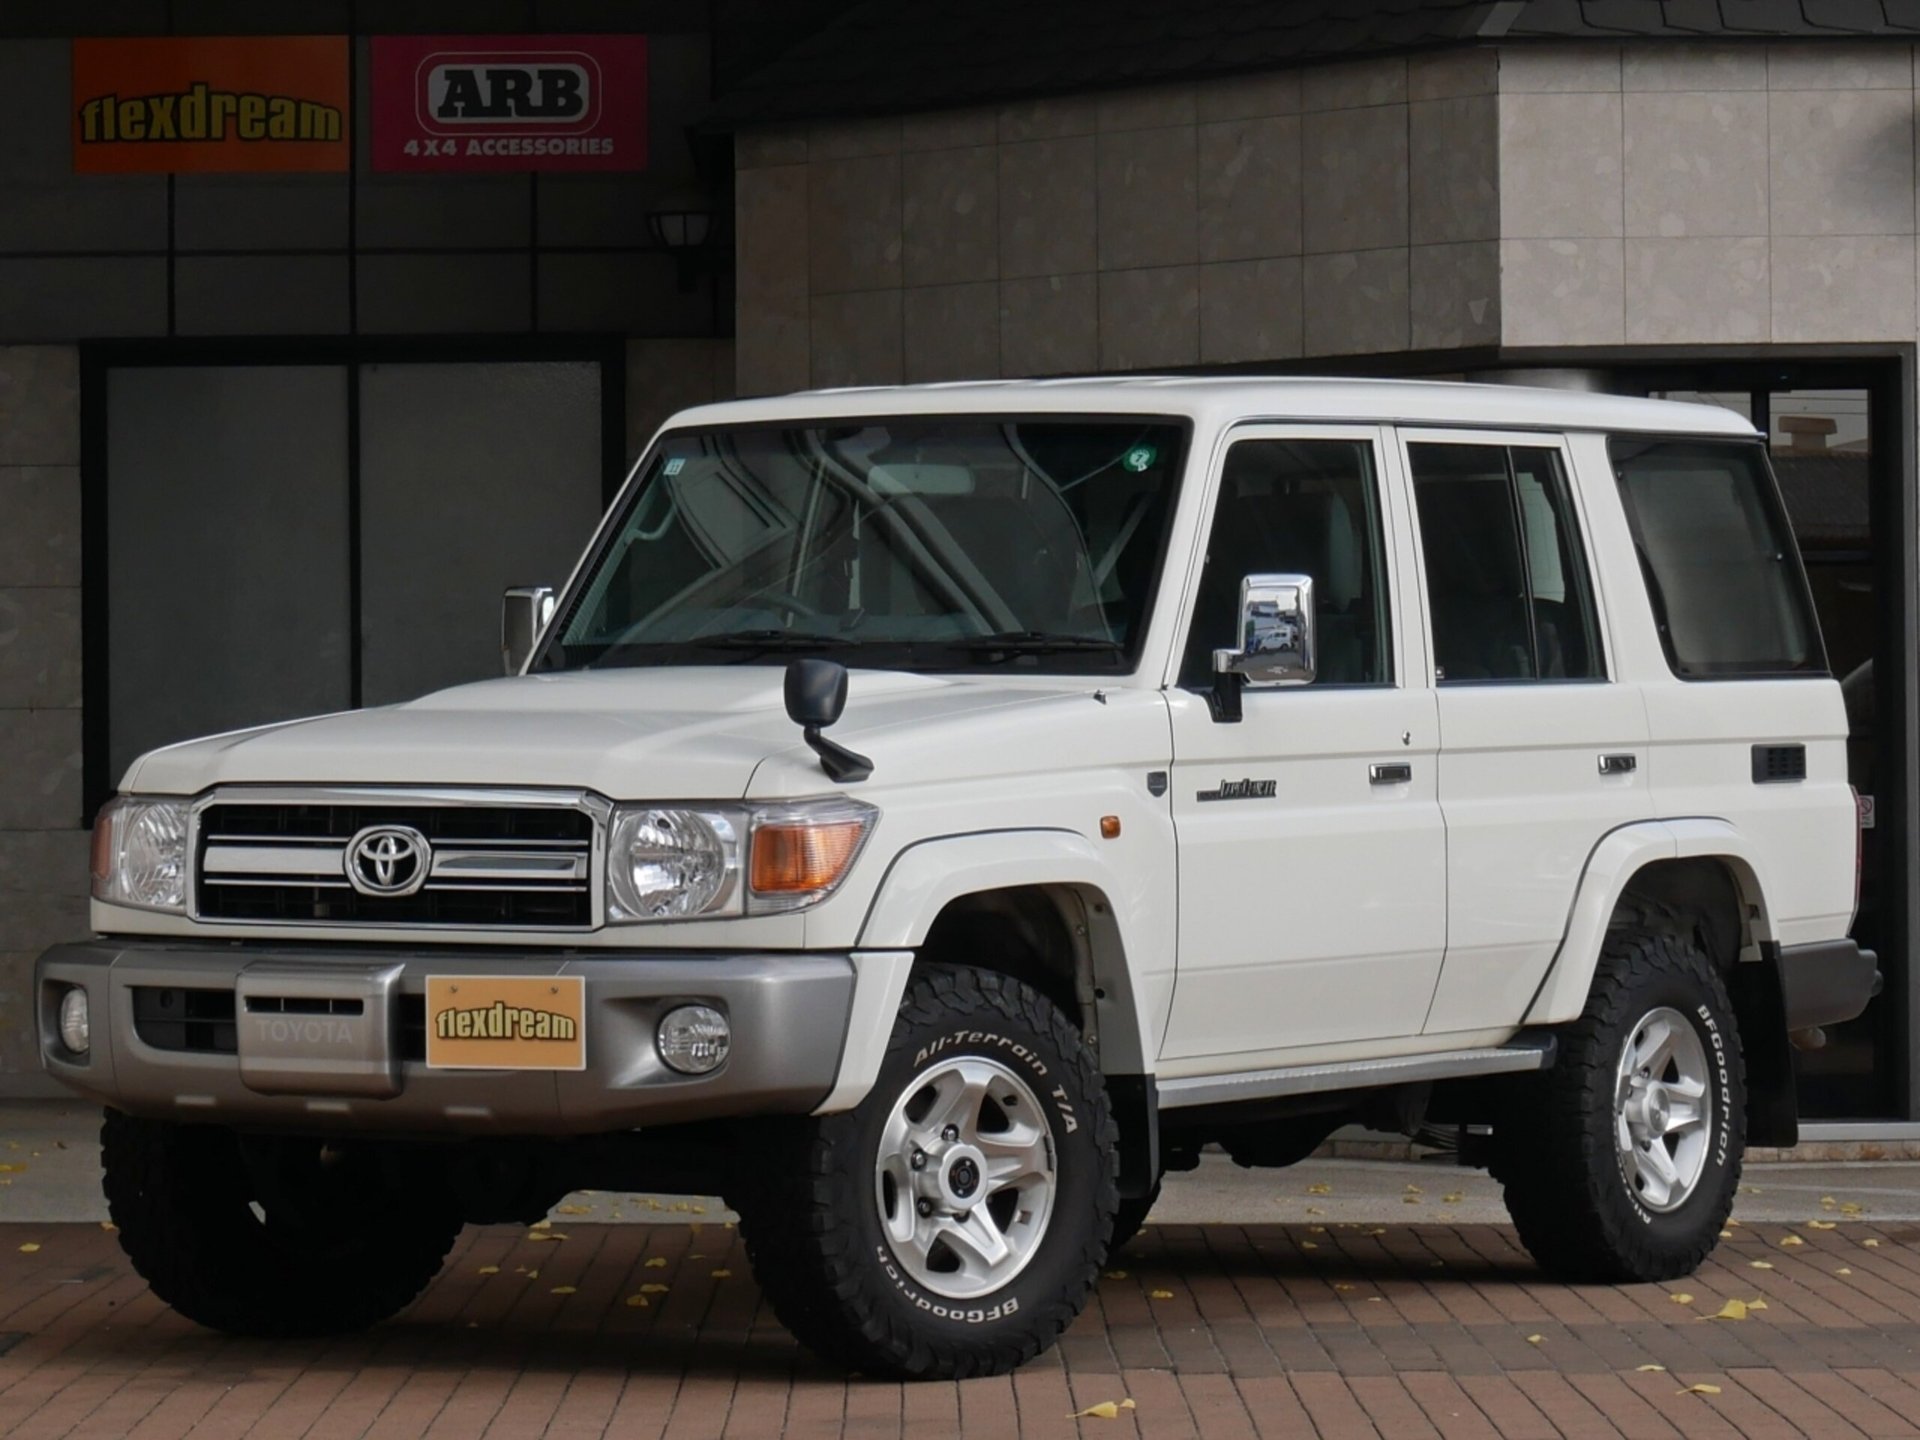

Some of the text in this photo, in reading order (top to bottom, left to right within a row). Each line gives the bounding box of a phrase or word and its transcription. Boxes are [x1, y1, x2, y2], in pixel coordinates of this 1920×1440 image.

[79, 82, 342, 143] flexdream
[437, 69, 583, 118] ARB
[403, 137, 614, 156] 4X4 ACCESSORIES
[255, 1019, 353, 1044] TOYOTA
[434, 1001, 577, 1040] flexdream
[913, 1029, 1079, 1134] All-Terrain T/A
[1697, 1004, 1731, 1167] BFGoodrich
[876, 1245, 1020, 1323] BFGoodrich
